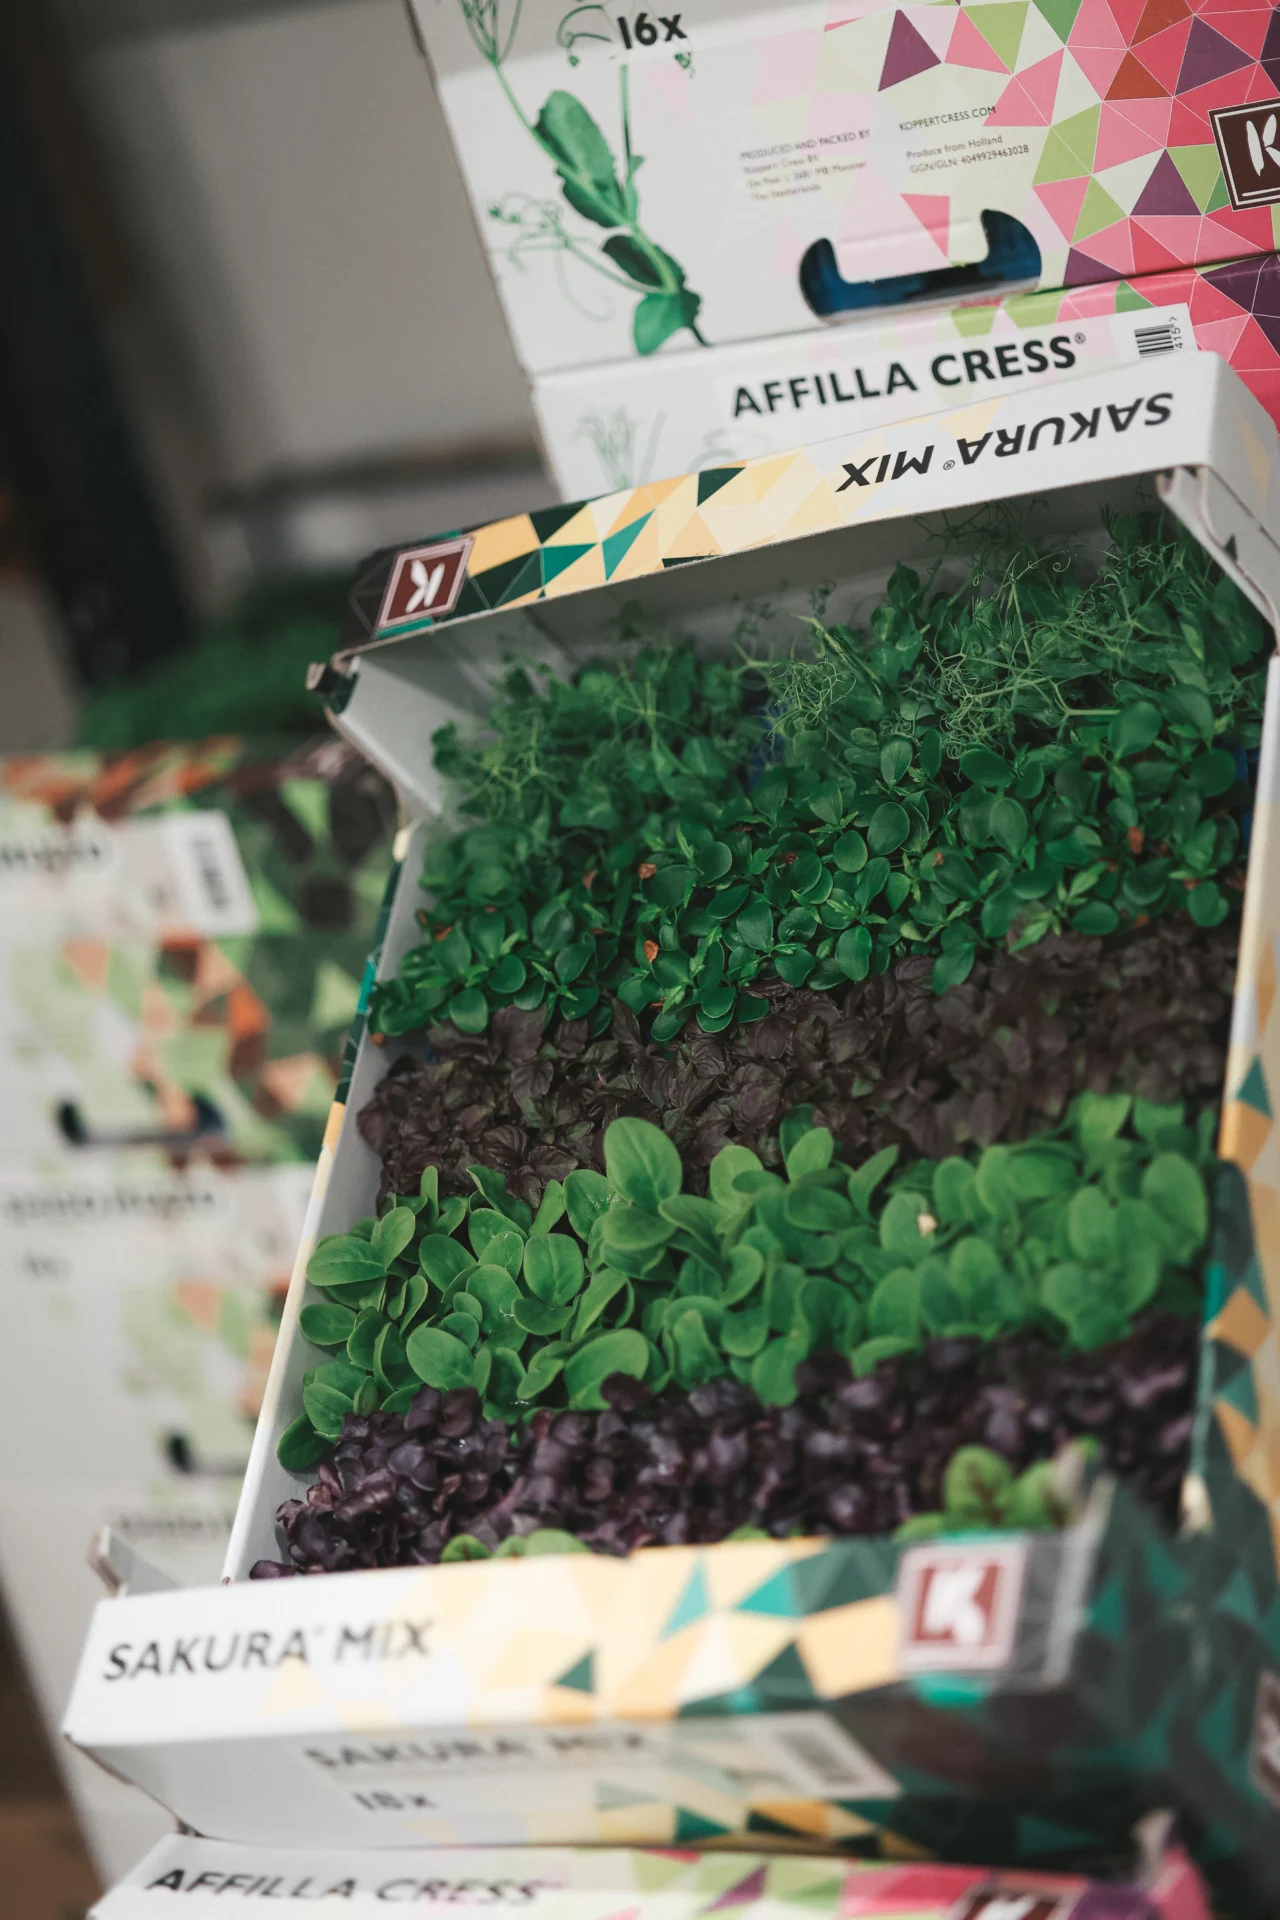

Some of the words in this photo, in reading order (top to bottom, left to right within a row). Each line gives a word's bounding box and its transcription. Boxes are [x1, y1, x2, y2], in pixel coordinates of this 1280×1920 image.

[617, 12, 688, 50] 16x
[899, 105, 997, 132] KOPPERTCRESS.COM
[906, 147, 942, 160] Produce
[943, 141, 967, 154] from
[968, 134, 1003, 149] Holland
[961, 144, 1030, 165] 4049929463028
[732, 361, 918, 419] AFFILLA
[834, 443, 936, 494] MIX
[333, 1617, 434, 1665] MIX
[144, 1867, 358, 1900] AFFILLA
